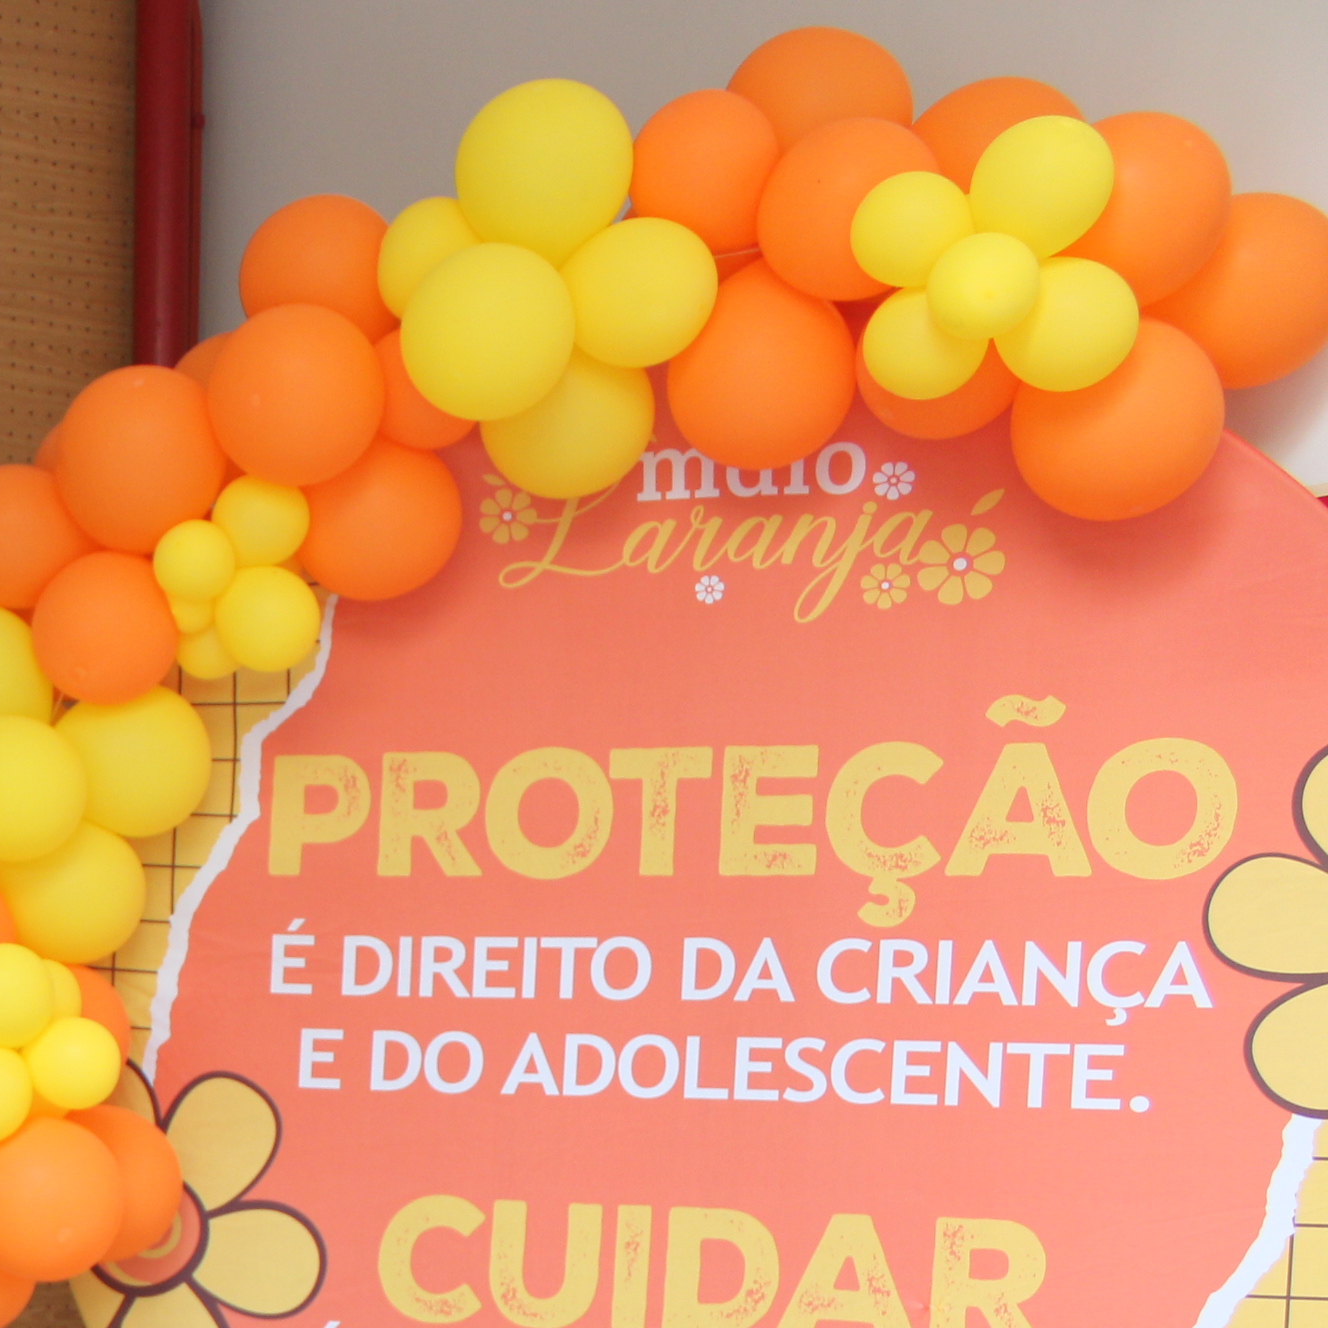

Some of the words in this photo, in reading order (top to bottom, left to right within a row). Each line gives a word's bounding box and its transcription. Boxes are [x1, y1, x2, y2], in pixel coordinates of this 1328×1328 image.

[498, 481, 933, 624] Laranja
[267, 694, 1240, 929] PROTEÇÃO
[269, 920, 315, 995] É
[341, 935, 652, 1001] DIREITO
[681, 937, 796, 1002] DA
[816, 937, 1214, 1027] CRIANÇA
[298, 1028, 344, 1090] E
[370, 1030, 484, 1094] DO
[500, 1032, 1150, 1113] ADOLESCENTE.
